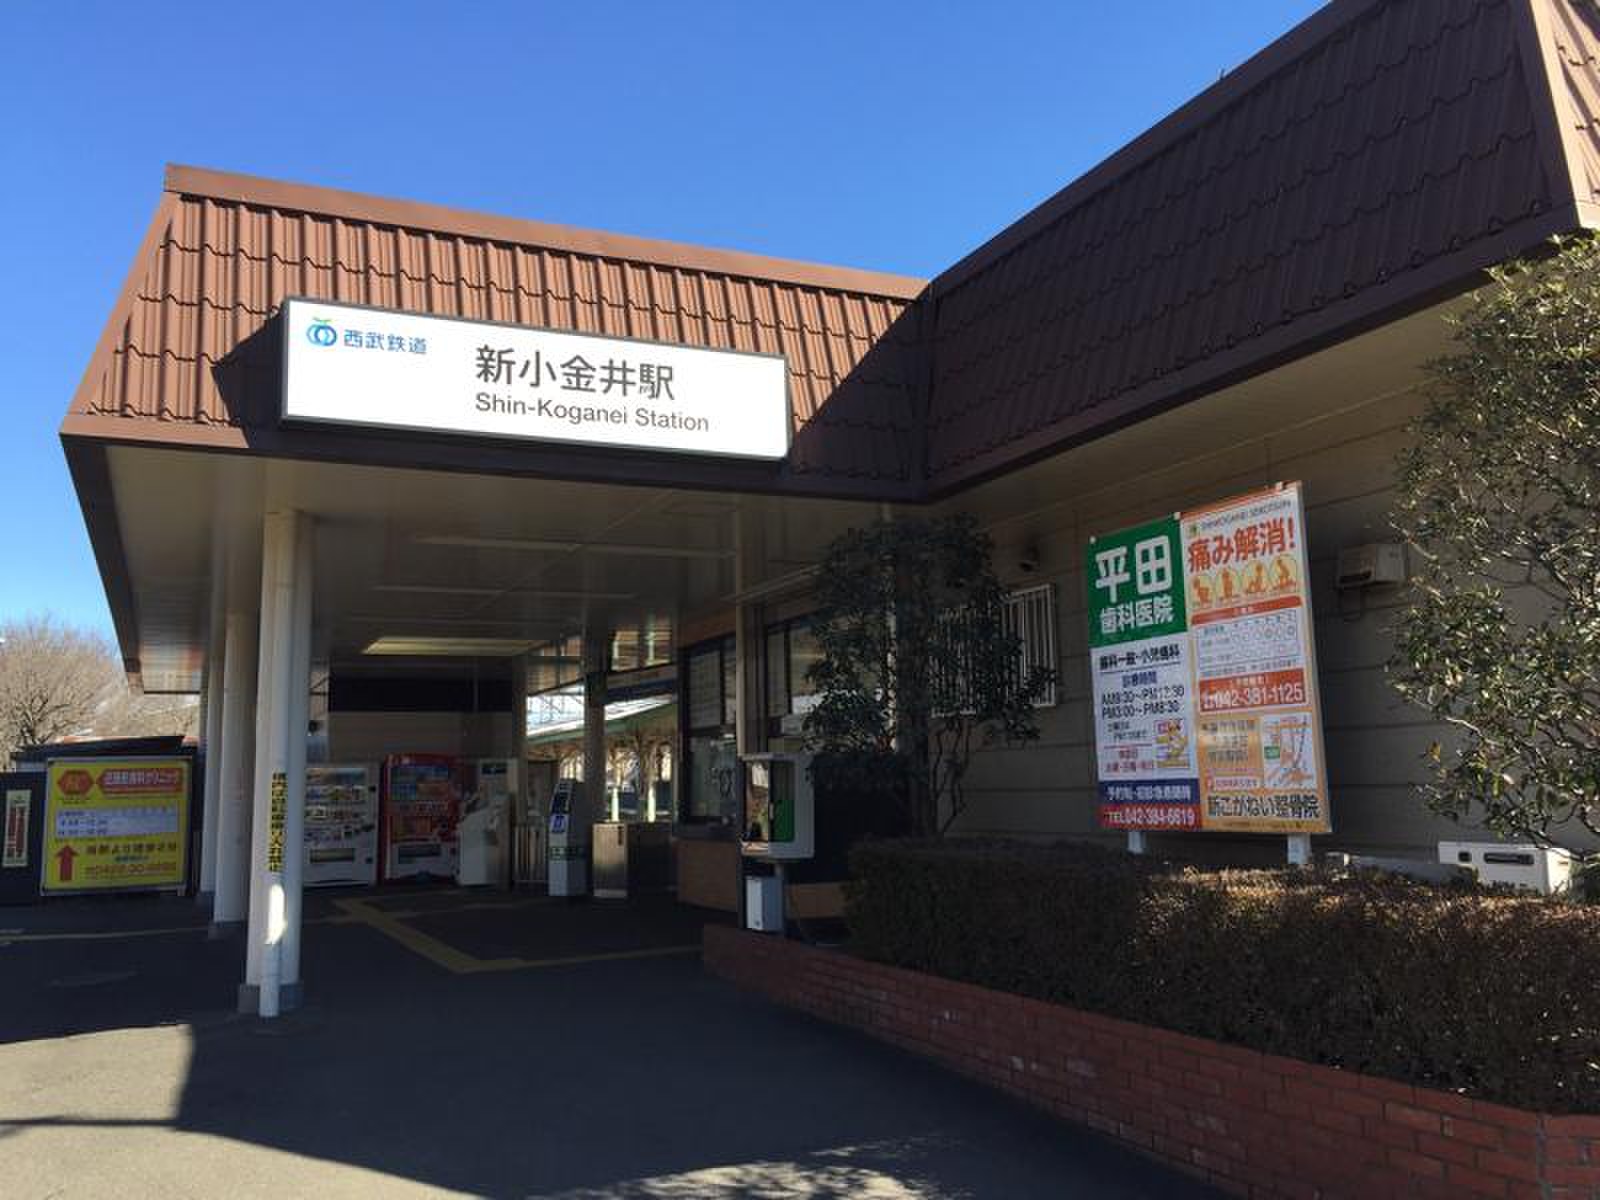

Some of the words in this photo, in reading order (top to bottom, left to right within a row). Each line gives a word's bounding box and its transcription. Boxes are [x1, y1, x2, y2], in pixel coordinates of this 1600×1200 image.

[343, 328, 428, 355] 西武鉄道
[475, 344, 675, 401] 新小金井駅
[475, 391, 628, 425] Shin-Koganei
[635, 407, 710, 433] Station
[1095, 535, 1172, 603] 平田
[1100, 594, 1174, 635] 歯科医院
